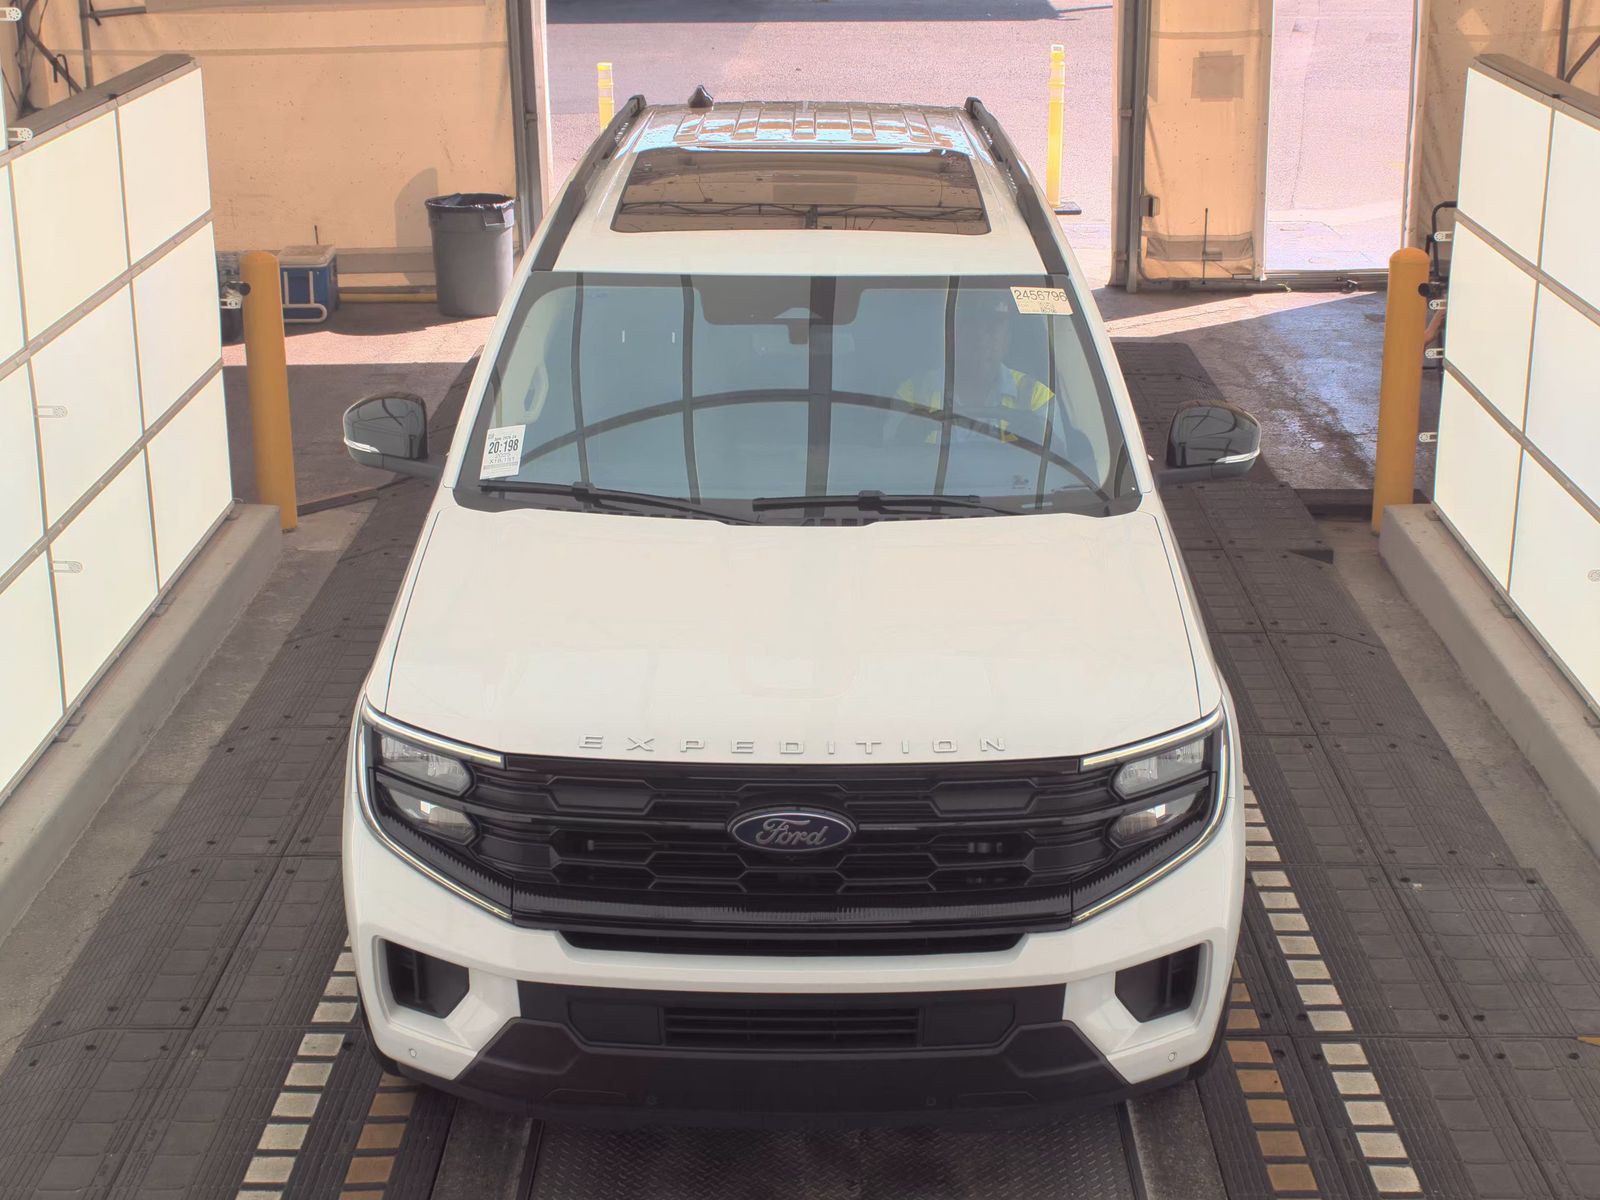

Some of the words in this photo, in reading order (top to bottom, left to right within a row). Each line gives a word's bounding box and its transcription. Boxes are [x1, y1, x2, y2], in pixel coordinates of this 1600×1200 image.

[1014, 289, 1067, 302] 2456796
[488, 439, 519, 454] 20:198
[578, 735, 1007, 755] EXPEDITION
[755, 818, 829, 845] Ford
